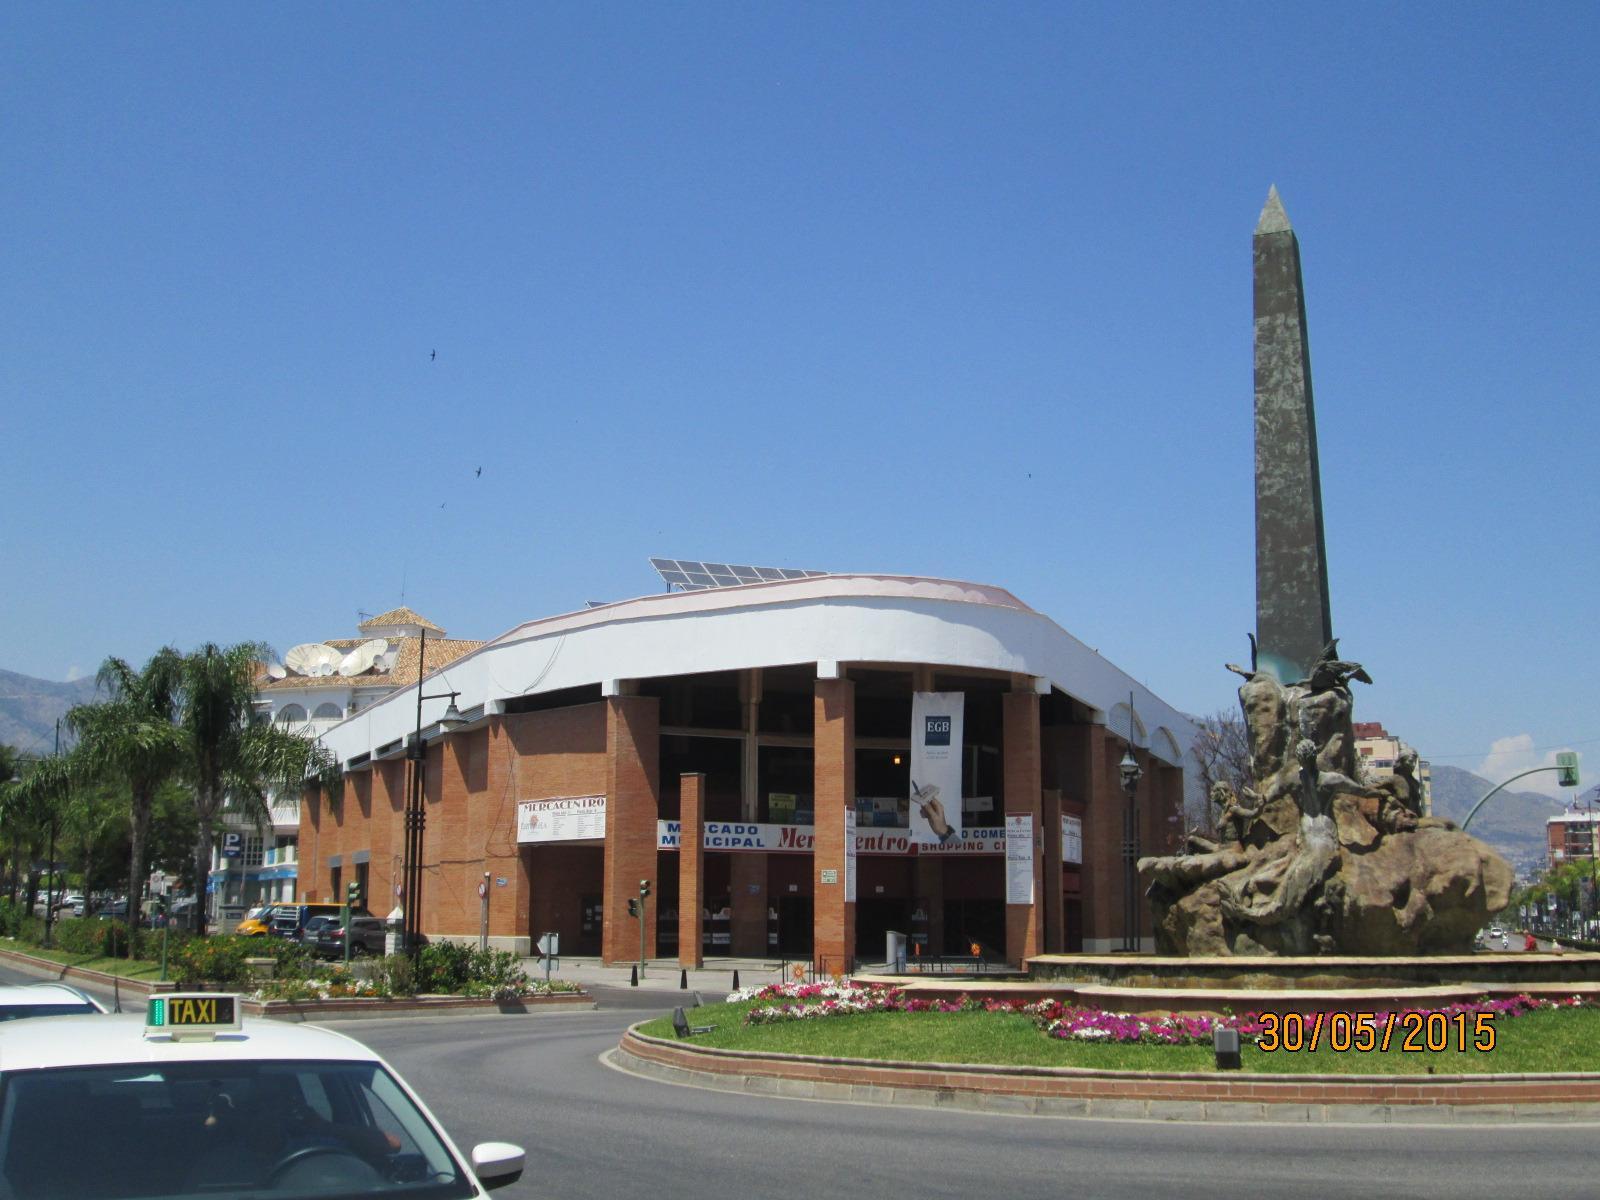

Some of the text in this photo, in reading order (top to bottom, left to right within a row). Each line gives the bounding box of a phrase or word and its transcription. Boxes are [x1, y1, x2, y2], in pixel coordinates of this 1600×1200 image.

[927, 721, 950, 733] EGB
[667, 823, 758, 835] MCADO
[226, 834, 239, 846] P
[661, 835, 765, 847] MICIPAL
[169, 999, 216, 1023] TAXI
